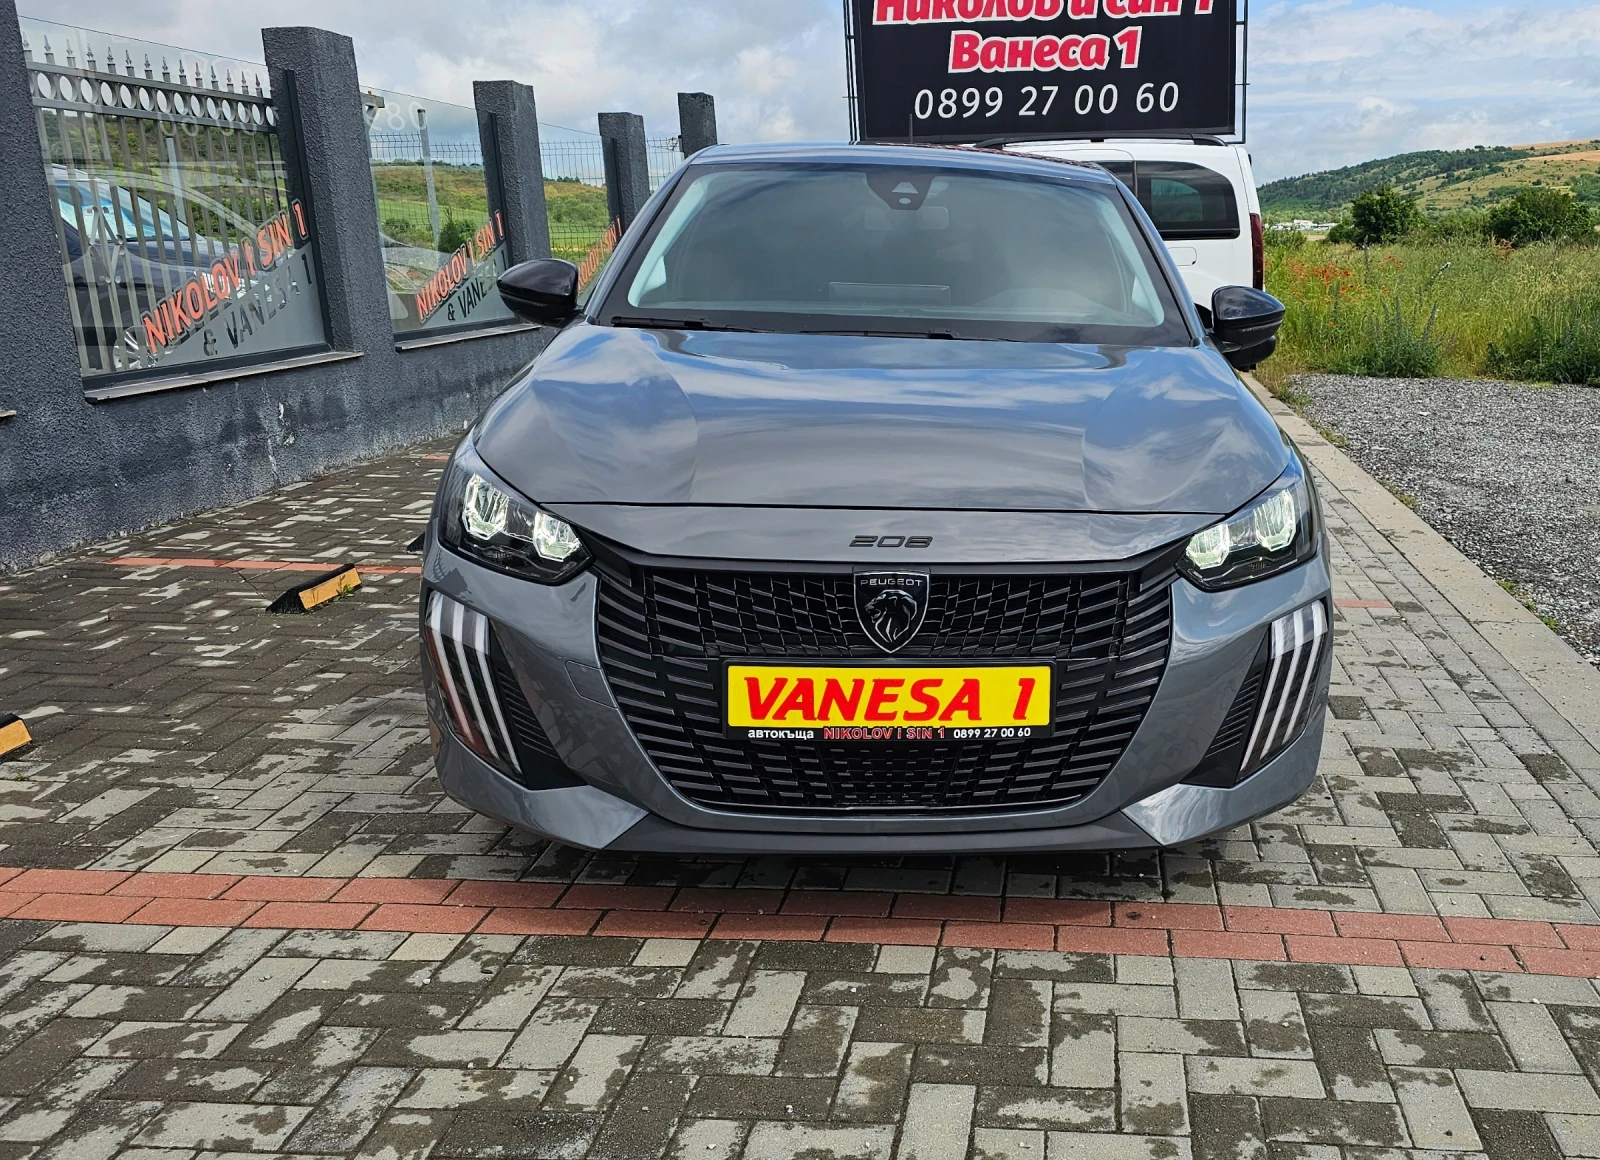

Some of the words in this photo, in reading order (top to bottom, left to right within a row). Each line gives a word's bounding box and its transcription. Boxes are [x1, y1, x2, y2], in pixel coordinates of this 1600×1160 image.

[948, 30, 1110, 73] Ванеса
[1113, 26, 1143, 68] 1
[914, 86, 1003, 119] 0899
[1019, 85, 1059, 117] 27
[1074, 83, 1118, 115] 00
[1136, 81, 1179, 113] 60
[142, 247, 241, 354] NIKOLOV
[242, 238, 257, 277] I
[257, 211, 294, 268] SIN
[292, 200, 308, 239] 1
[416, 244, 467, 321] NIKOLOV
[475, 219, 496, 260] SIN
[203, 328, 218, 356] &
[224, 265, 301, 349] VANESA
[301, 252, 313, 285] 1
[447, 302, 456, 321] &
[849, 535, 933, 548] 208
[860, 578, 923, 587] PEUGEOT
[743, 677, 982, 721] VANESA
[1012, 678, 1036, 721] 1
[748, 729, 814, 740] автокъща
[823, 727, 893, 740] NIKOLOV
[906, 727, 933, 739] SIN
[937, 727, 945, 739] 1
[953, 728, 982, 739] 0899
[984, 728, 998, 739] 27
[1000, 728, 1015, 738] 00
[1017, 727, 1031, 738] 60
